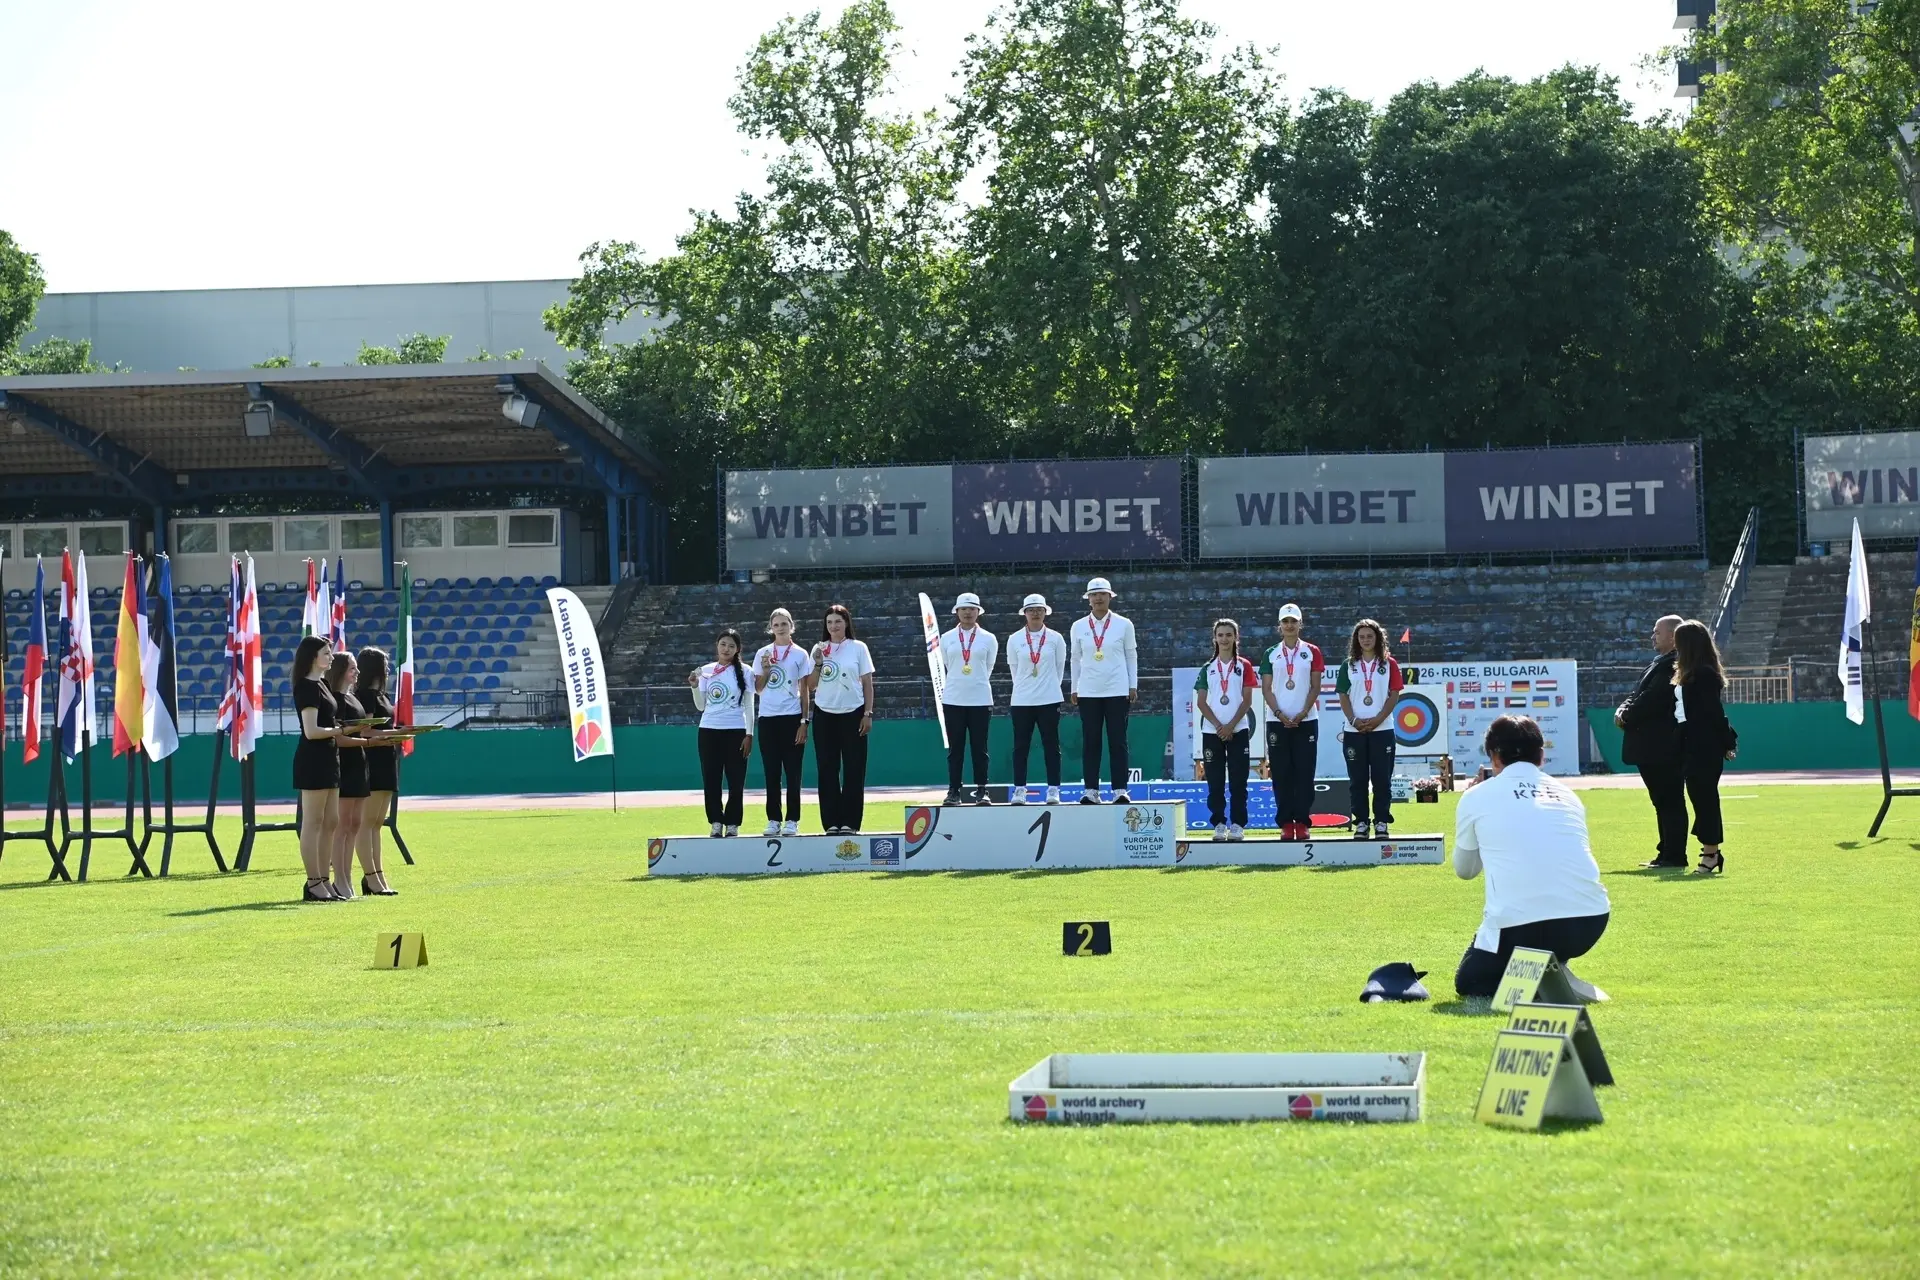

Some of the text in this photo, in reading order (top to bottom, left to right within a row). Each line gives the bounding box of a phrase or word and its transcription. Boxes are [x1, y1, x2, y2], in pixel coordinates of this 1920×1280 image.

[1235, 489, 1417, 527] WINBET
[1479, 480, 1664, 521] WINBET
[751, 501, 927, 539] WINBET
[983, 497, 1161, 535] WINBET
[556, 597, 584, 708] world archery
[581, 646, 597, 703] europe
[1406, 668, 1414, 684] 2
[1441, 667, 1480, 679] RUSE,
[1483, 665, 1550, 677] BULGARIA
[1028, 810, 1052, 863] 1
[1123, 836, 1164, 844] EUROPEAN
[766, 838, 783, 867] 2
[1304, 843, 1314, 862] 3
[390, 934, 403, 967] 1
[1076, 923, 1093, 956] 2
[1506, 958, 1545, 981] SHOOTING
[1504, 986, 1525, 1005] LINE
[1495, 1047, 1554, 1077] WAITING
[1062, 1096, 1145, 1109] world archery
[1326, 1095, 1410, 1107] world archery
[1326, 1110, 1369, 1121] europe
[1495, 1088, 1529, 1117] LINE
